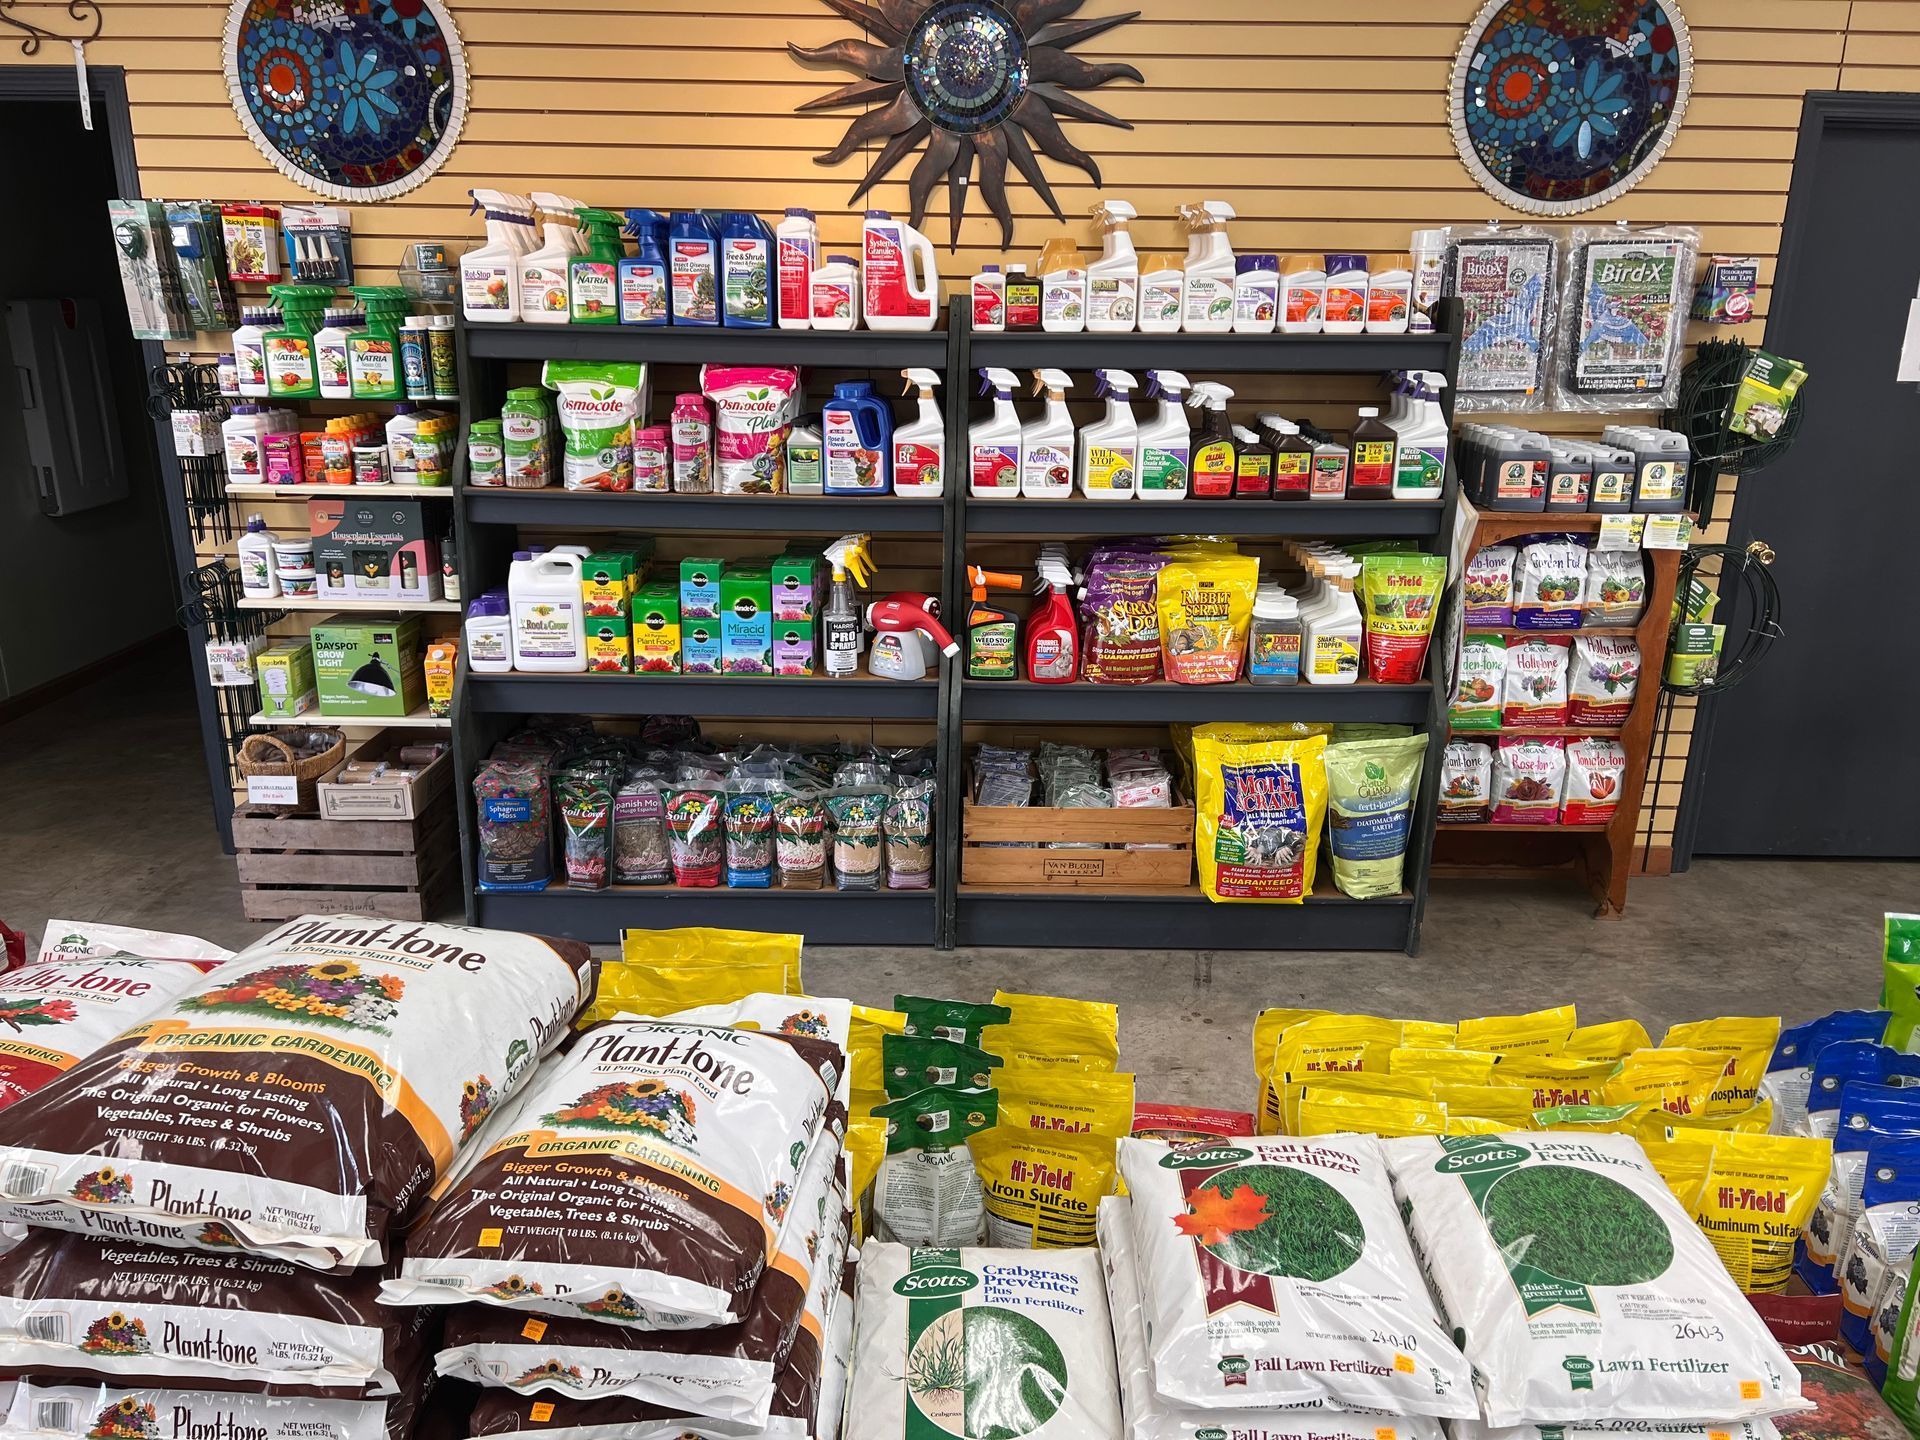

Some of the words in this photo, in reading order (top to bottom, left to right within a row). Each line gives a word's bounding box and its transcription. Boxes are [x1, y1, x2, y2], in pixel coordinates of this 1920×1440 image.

[869, 239, 899, 249] Systemic
[726, 252, 740, 260] Tree
[744, 252, 765, 260] Shrub
[868, 247, 896, 256] Granules
[1600, 262, 1665, 283] Bird-X
[577, 276, 609, 285] NATRIA
[273, 353, 304, 361] NATRIA
[357, 354, 387, 362] NATRIA
[509, 426, 535, 434] Osmocote
[899, 451, 910, 463] Bt
[1090, 449, 1113, 458] WILT
[1090, 457, 1114, 465] STOP
[331, 531, 367, 540] Houseplant
[369, 532, 404, 540] Essentials
[1186, 604, 1229, 617] SCRAM
[527, 621, 543, 630] Root
[728, 624, 765, 633] Miracid
[315, 633, 324, 641] 8"
[831, 632, 855, 641] PRO
[1273, 636, 1298, 644] DEER
[316, 642, 358, 650] DAYSPOT
[831, 641, 856, 649] SPRAYER
[318, 659, 342, 667] LIGHT
[1235, 775, 1291, 793] MOLE
[489, 805, 525, 813] Sphagnum
[562, 806, 580, 817] Soil
[582, 810, 605, 818] Cover
[1373, 823, 1393, 831] EARTH
[1221, 878, 1292, 886] GUARANTEED
[54, 945, 93, 954] ORGANIC
[270, 920, 485, 973] Plant-tone
[302, 944, 358, 956] Purpose
[361, 949, 397, 962] Plant
[399, 956, 433, 970] Food
[626, 1024, 751, 1048] ORGANIC
[155, 1030, 270, 1048] ORGANIC
[276, 1036, 394, 1090] GARDENING
[581, 1036, 754, 1097] Plant-tone
[119, 1058, 172, 1074] Bigger
[177, 1060, 237, 1080] Growth
[242, 1070, 256, 1083] &
[262, 1072, 326, 1093] Blooms
[118, 1072, 140, 1087] All
[144, 1074, 199, 1091] Natural
[213, 1083, 249, 1102] Long
[254, 1087, 309, 1110] Lasting
[80, 1087, 107, 1100] The
[111, 1089, 170, 1109] Original
[175, 1094, 231, 1118] Organic
[236, 1101, 258, 1116] for
[262, 1105, 325, 1134] Flowers,
[96, 1105, 175, 1129] Vegetables,
[178, 1114, 216, 1130] Trees
[221, 1118, 236, 1132] &
[244, 1121, 291, 1142] Shrubs
[105, 1127, 127, 1138] NET
[130, 1129, 169, 1144] WEIGHT
[172, 1133, 184, 1146] 36
[187, 1134, 206, 1148] LBS.
[211, 1137, 240, 1153] (16.32
[242, 1141, 257, 1155] kg)
[1529, 1142, 1596, 1154] Lawn
[917, 1153, 956, 1165] ORGANIC
[1257, 1144, 1290, 1156] Fall
[1294, 1146, 1360, 1166] Lawn
[1448, 1150, 1518, 1169] Scotts
[1534, 1149, 1643, 1172] Fertilizer
[1260, 1153, 1361, 1176] Fertilizer
[1011, 1160, 1073, 1191] Hi-Yield
[992, 1180, 1029, 1198] Iron
[1032, 1188, 1088, 1212] Sulfate
[1718, 1187, 1786, 1213] Hi-Yield
[1696, 1213, 1760, 1234] Aluminum
[983, 1265, 1079, 1284] Crabgrass
[902, 1274, 968, 1290] Scotts
[984, 1275, 1080, 1296] Preventer
[984, 1286, 1013, 1295] Plus
[984, 1295, 1021, 1304] Lawn
[1025, 1297, 1085, 1316] Fertilizer
[1764, 1316, 1782, 1324] Covers
[1675, 1324, 1724, 1343] 26-0-3
[163, 1321, 258, 1364] Plant-tone
[1372, 1329, 1417, 1352] 24-0-10
[1599, 1360, 1646, 1372] Lawn
[1649, 1358, 1729, 1374] Fertilizer
